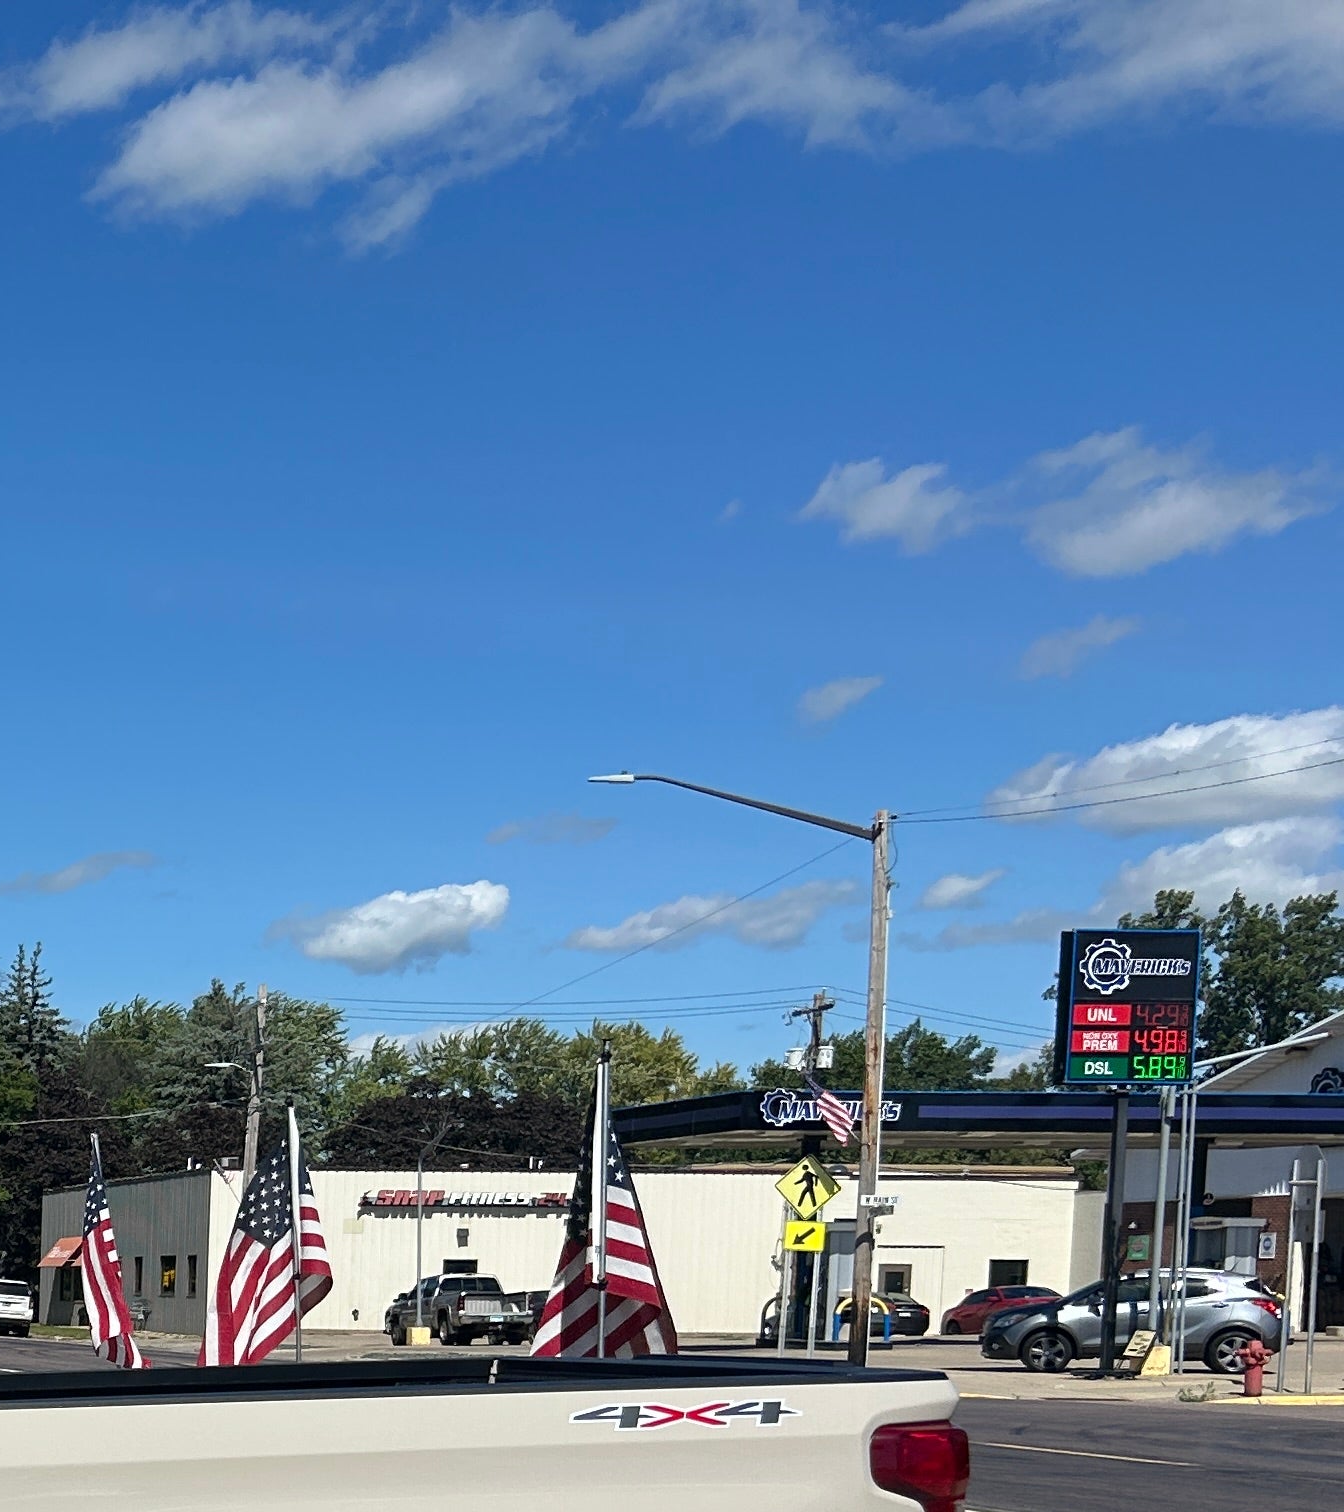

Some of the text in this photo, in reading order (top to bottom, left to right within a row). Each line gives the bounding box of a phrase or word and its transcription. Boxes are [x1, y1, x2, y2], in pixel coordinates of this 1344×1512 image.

[1087, 1008, 1117, 1022] UNL
[1083, 1040, 1118, 1051] PREM
[1084, 1062, 1113, 1075] DSL
